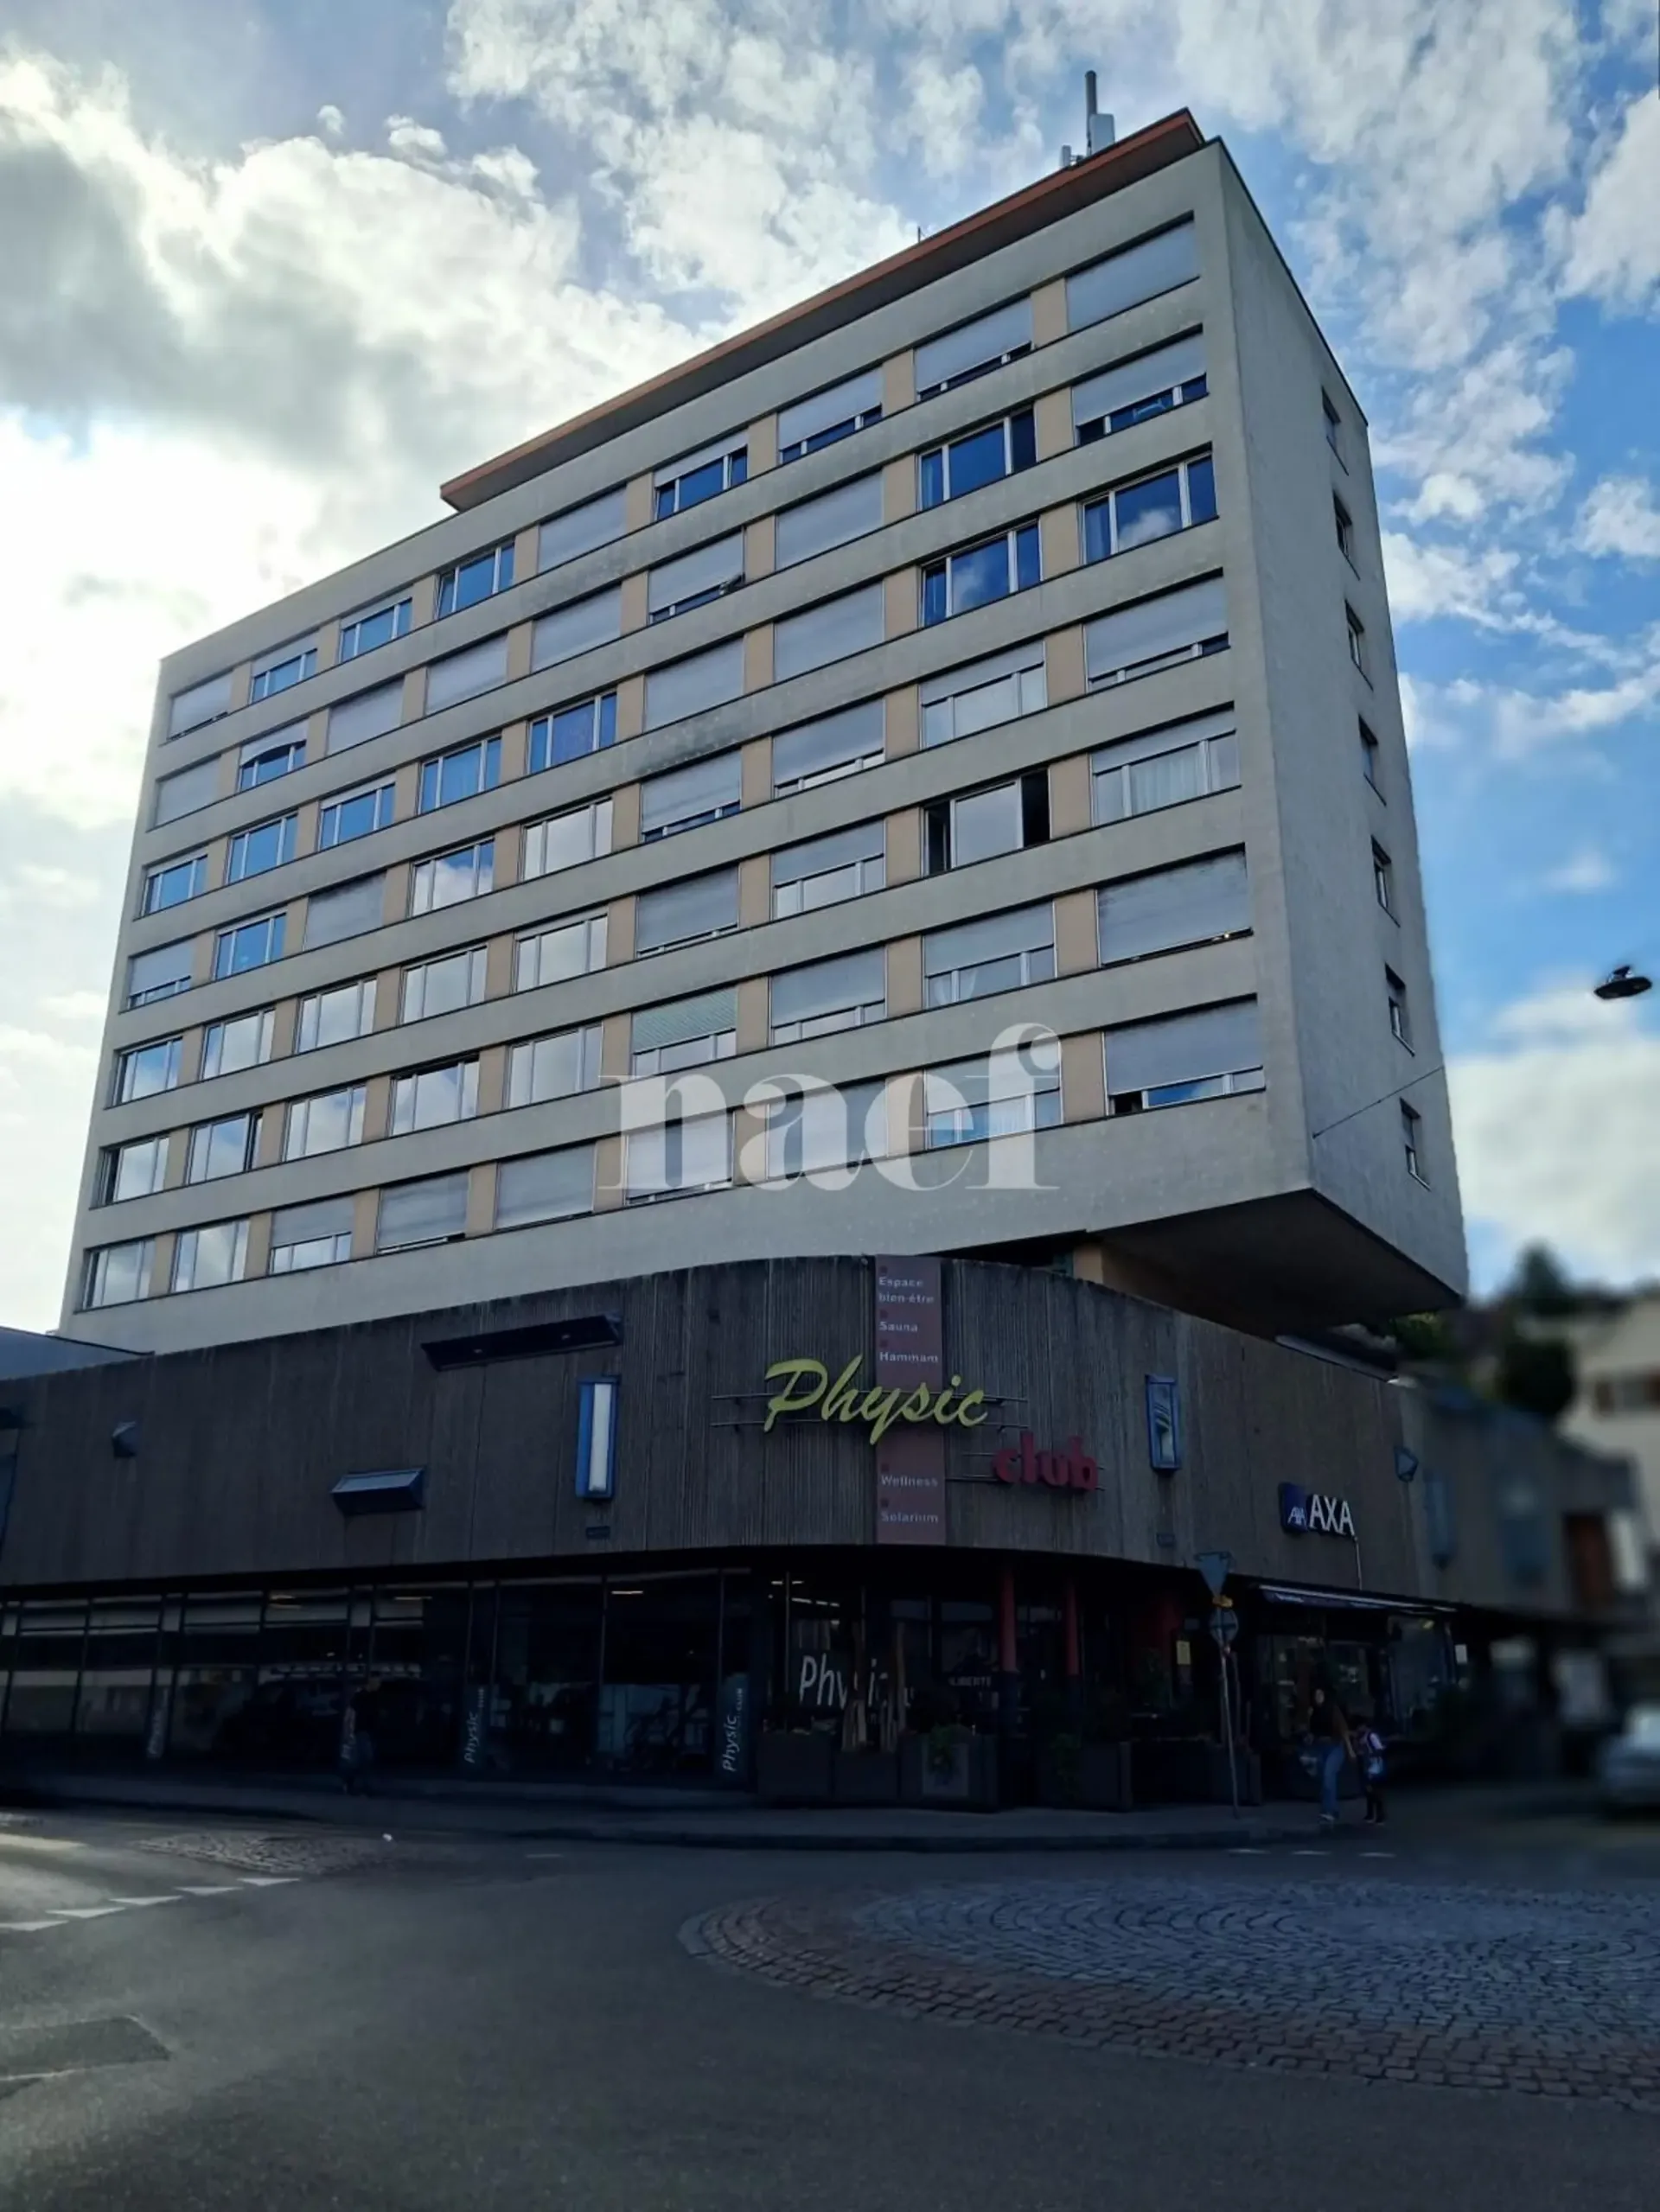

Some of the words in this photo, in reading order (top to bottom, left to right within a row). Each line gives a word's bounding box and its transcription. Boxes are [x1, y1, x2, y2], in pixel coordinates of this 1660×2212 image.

[878, 1277, 924, 1289] Espace
[878, 1321, 918, 1332] Sauna
[878, 1352, 938, 1363] Hammam
[763, 1355, 989, 1445] Physic
[993, 1432, 1099, 1491] club
[881, 1475, 938, 1487] Wellness
[881, 1511, 938, 1523] Solarium
[1309, 1494, 1355, 1536] AXA
[722, 1714, 740, 1772] Physic
